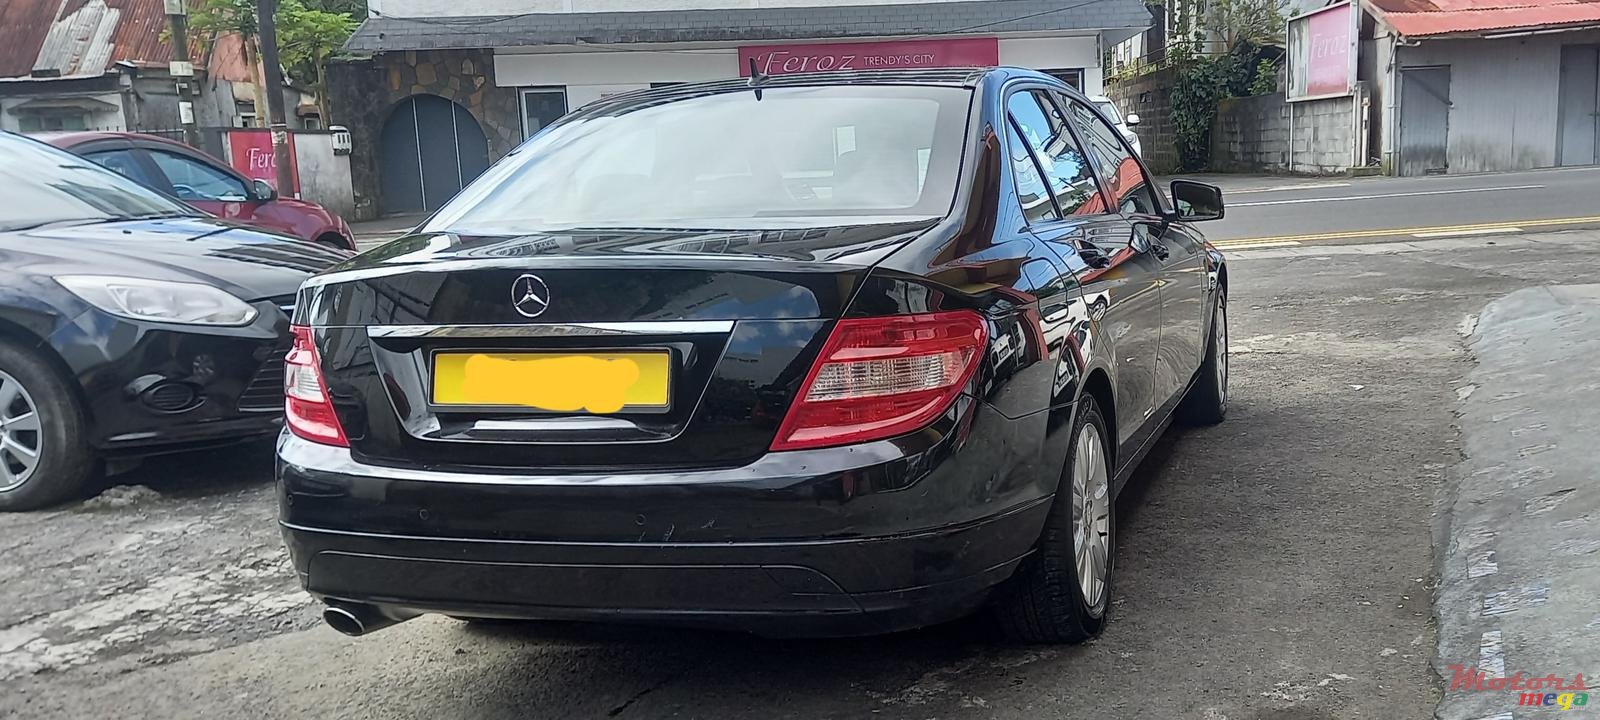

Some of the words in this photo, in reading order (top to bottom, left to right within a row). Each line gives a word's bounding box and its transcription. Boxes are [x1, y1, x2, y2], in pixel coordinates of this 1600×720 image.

[757, 51, 856, 73] Feroz
[863, 54, 910, 66] TRENDY'S
[913, 53, 935, 64] CITY
